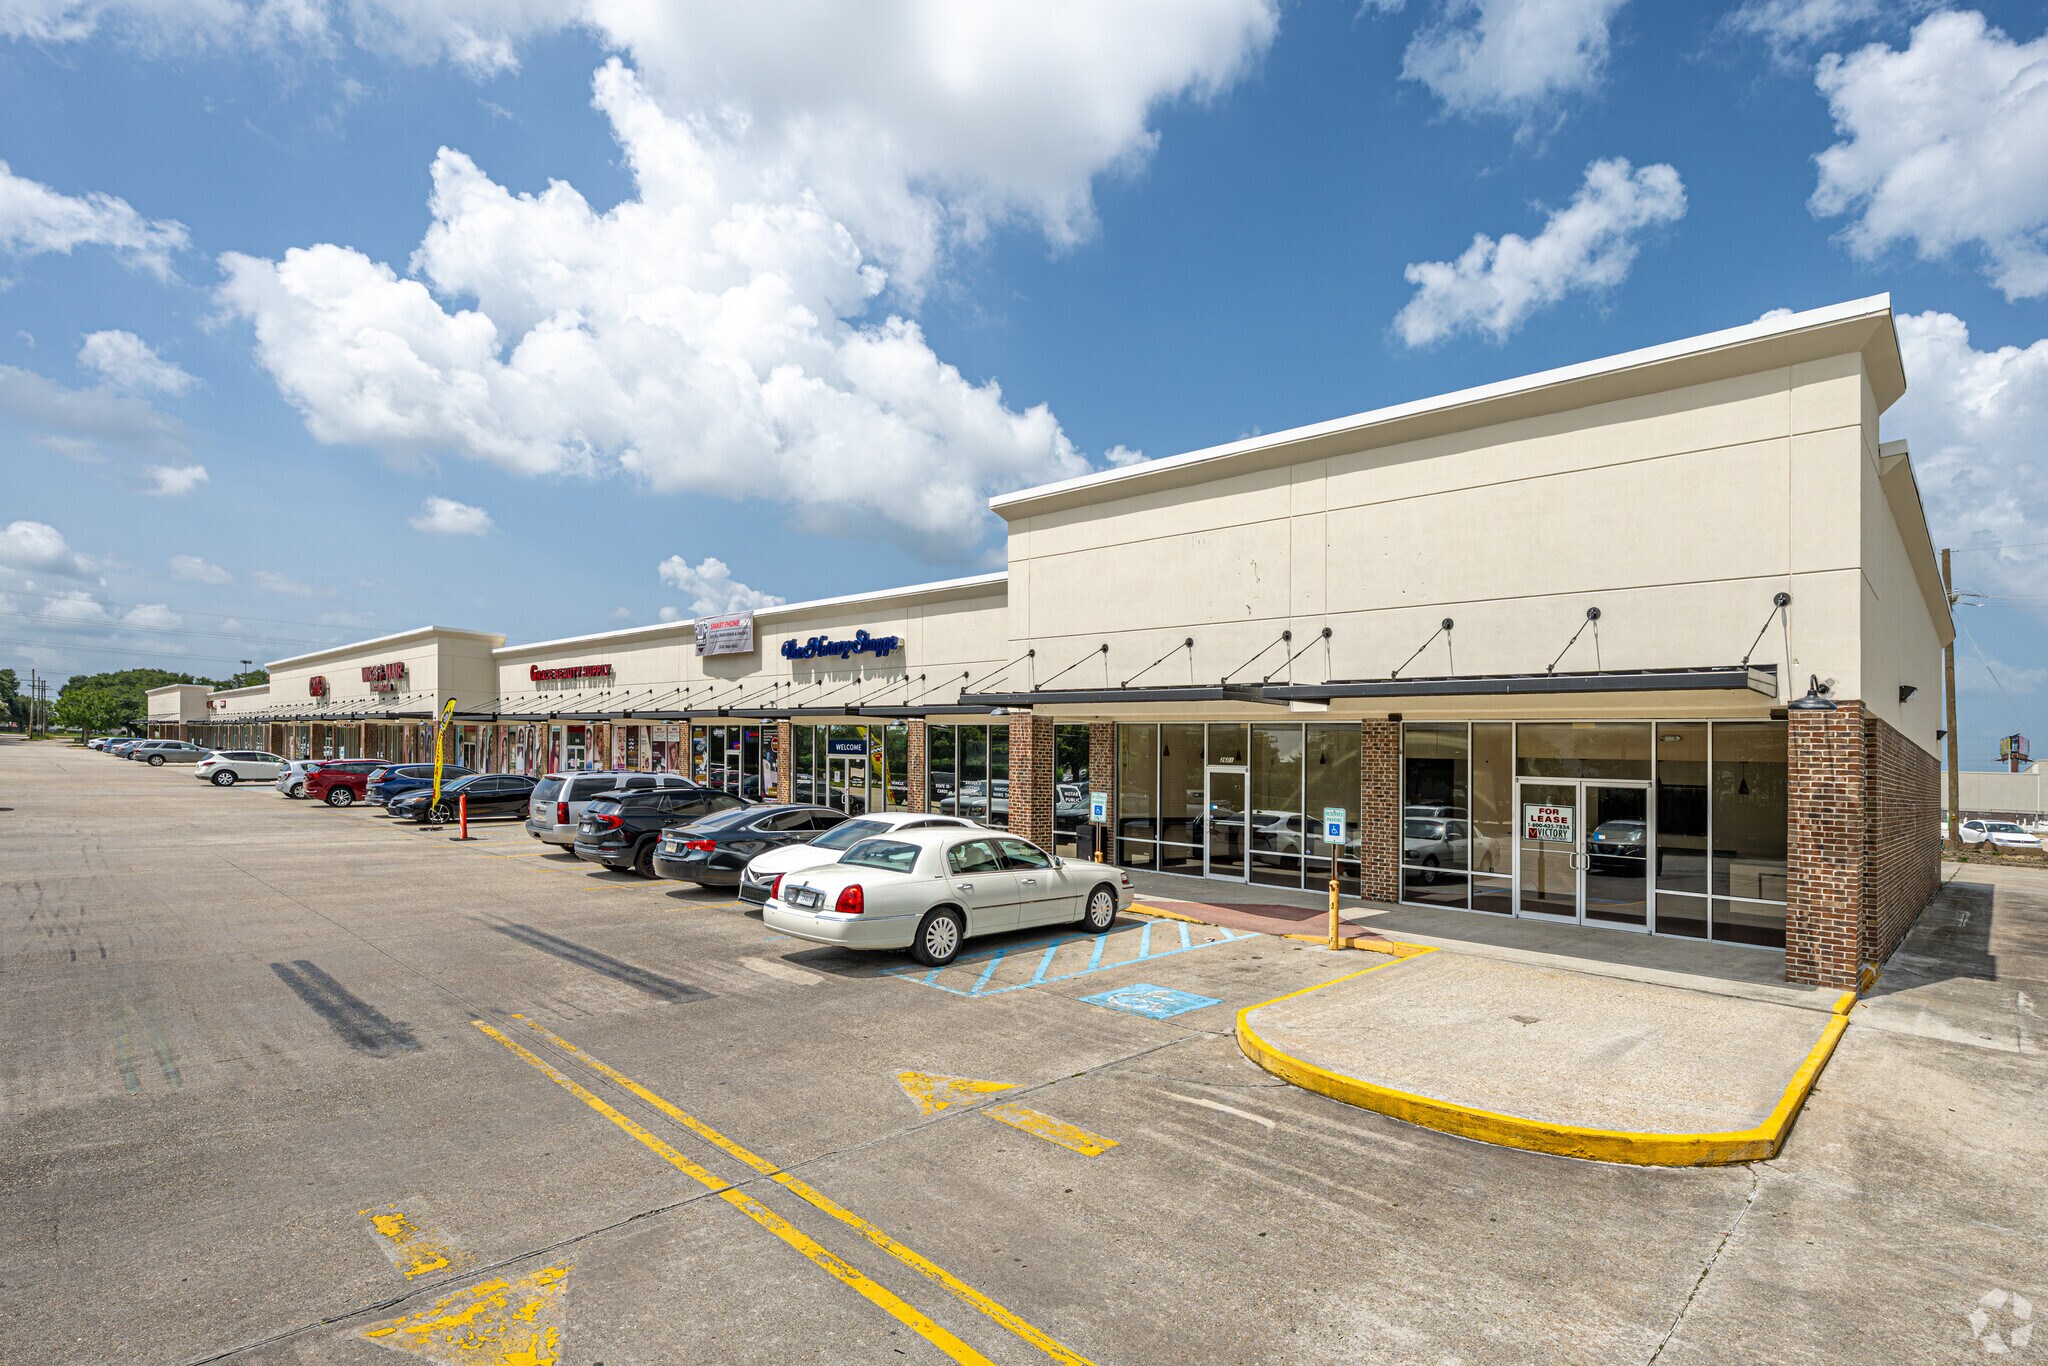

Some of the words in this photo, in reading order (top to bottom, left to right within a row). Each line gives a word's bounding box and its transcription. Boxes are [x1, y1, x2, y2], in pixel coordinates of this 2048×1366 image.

[710, 621, 724, 630] SMART
[724, 619, 740, 628] PHONE
[386, 662, 404, 679] HAIR
[554, 666, 582, 679] BEAUTY
[582, 664, 612, 677] SUPPLY
[836, 743, 862, 751] WELCOME
[1530, 815, 1568, 824] LEASE
[1538, 828, 1568, 838] VICTORY
